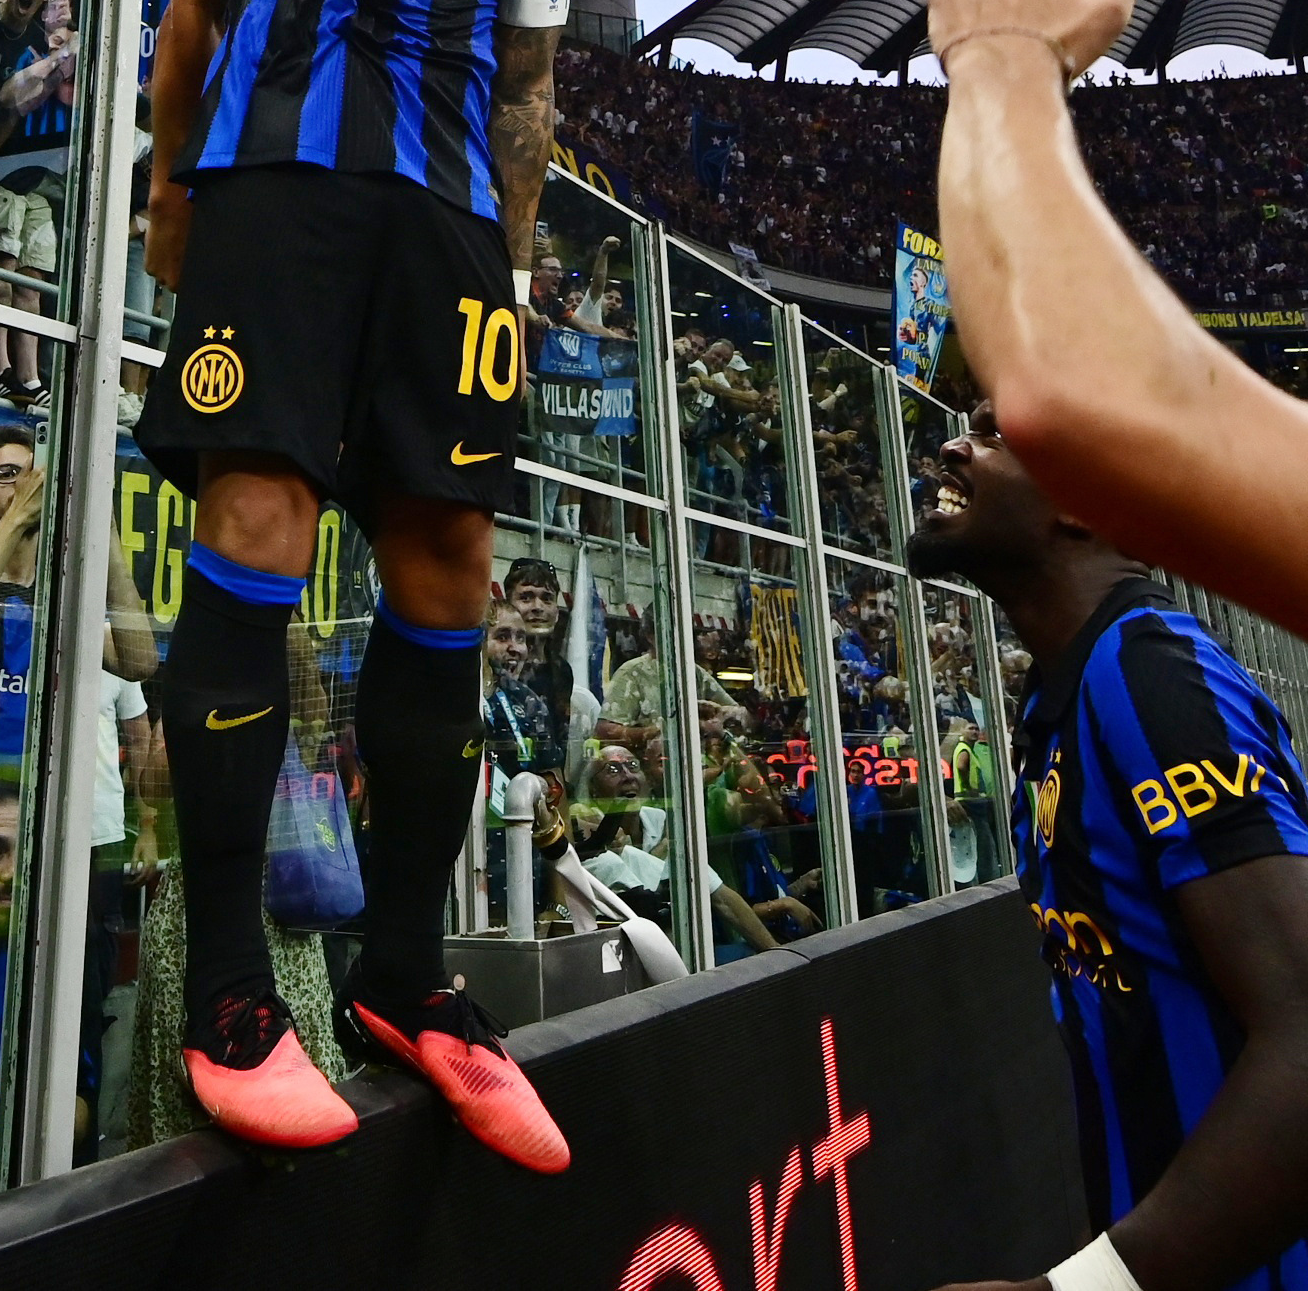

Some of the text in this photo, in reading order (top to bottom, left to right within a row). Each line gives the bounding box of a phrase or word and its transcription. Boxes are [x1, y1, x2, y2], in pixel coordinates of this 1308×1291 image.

[902, 227, 944, 260] FORZ
[1193, 311, 1238, 328] IBONSI
[456, 296, 519, 402] 10
